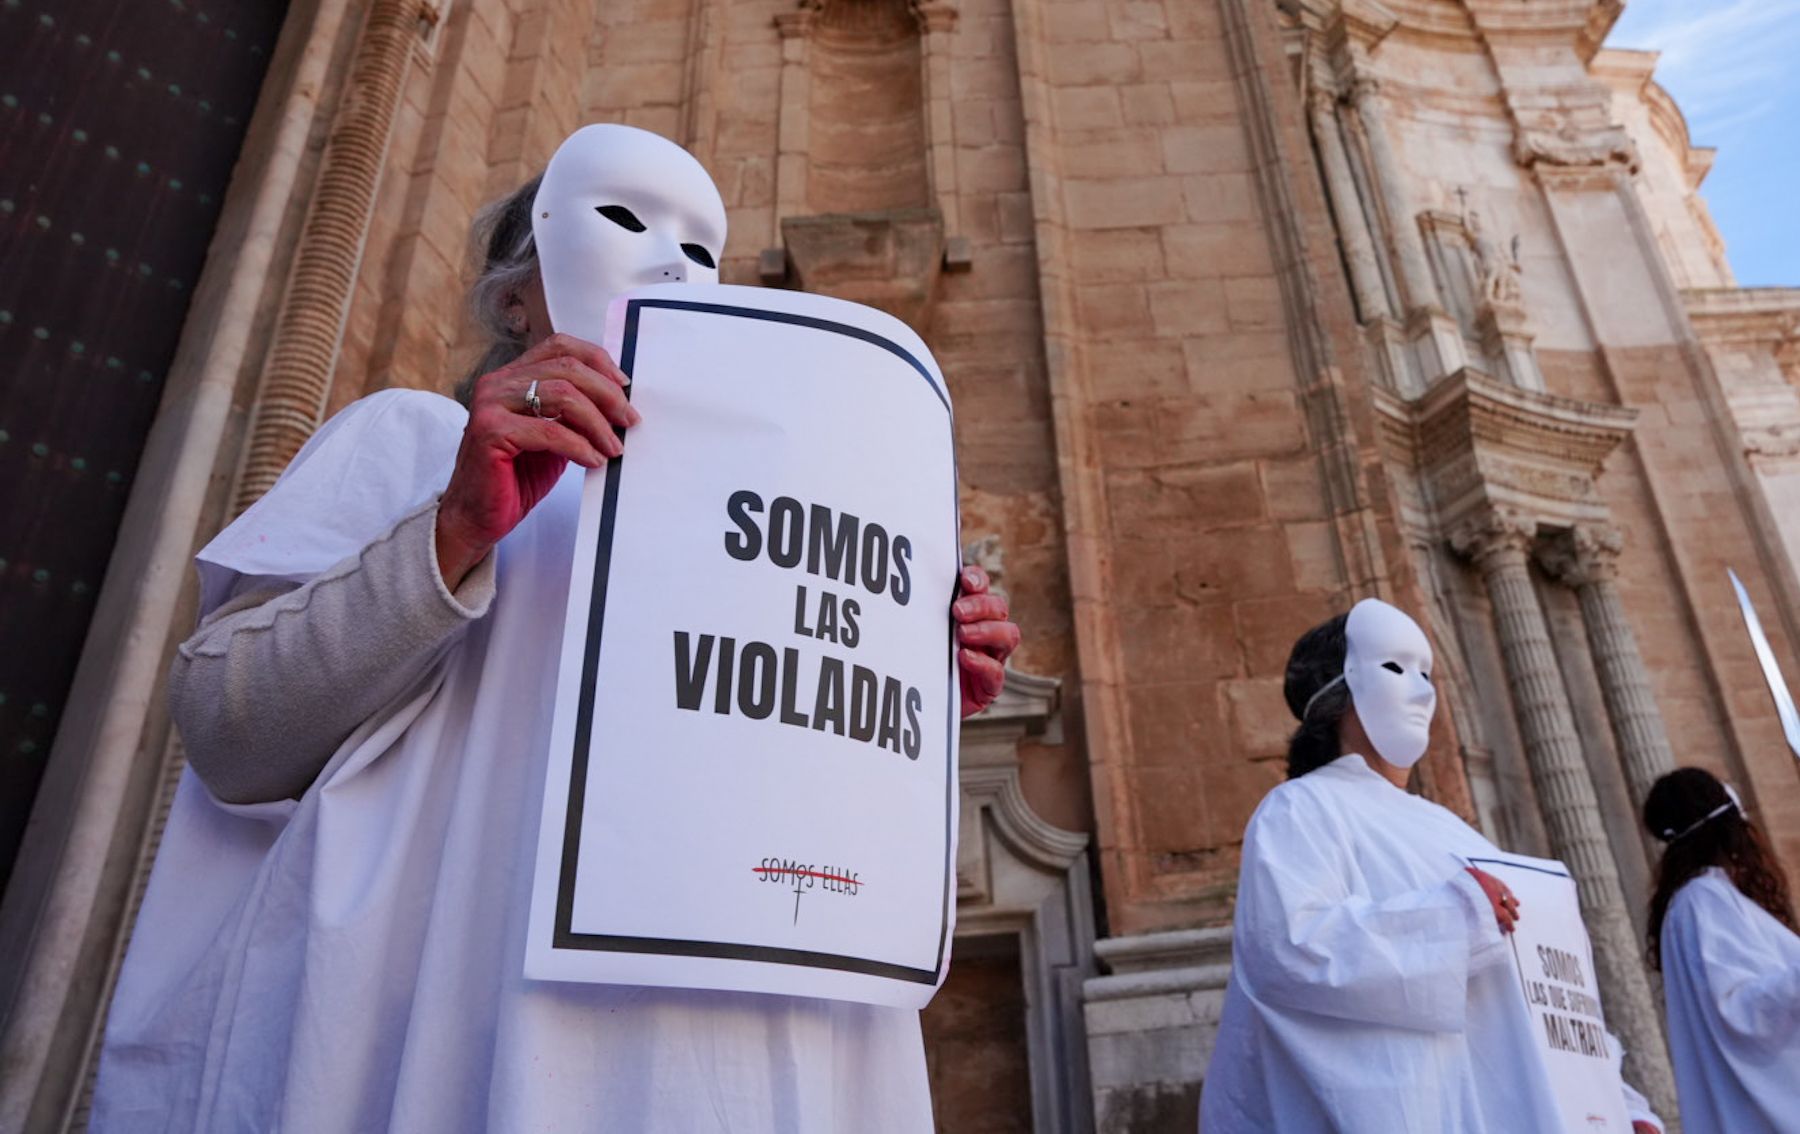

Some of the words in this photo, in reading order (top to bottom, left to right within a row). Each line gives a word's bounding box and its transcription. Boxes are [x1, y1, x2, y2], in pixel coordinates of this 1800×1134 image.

[725, 490, 912, 606] SOMOS
[794, 584, 861, 648] LAS
[673, 630, 922, 761] VIOLADAS
[758, 857, 815, 889] SOMOS
[822, 865, 859, 896] ELLAS
[1526, 979, 1548, 1006] LAS
